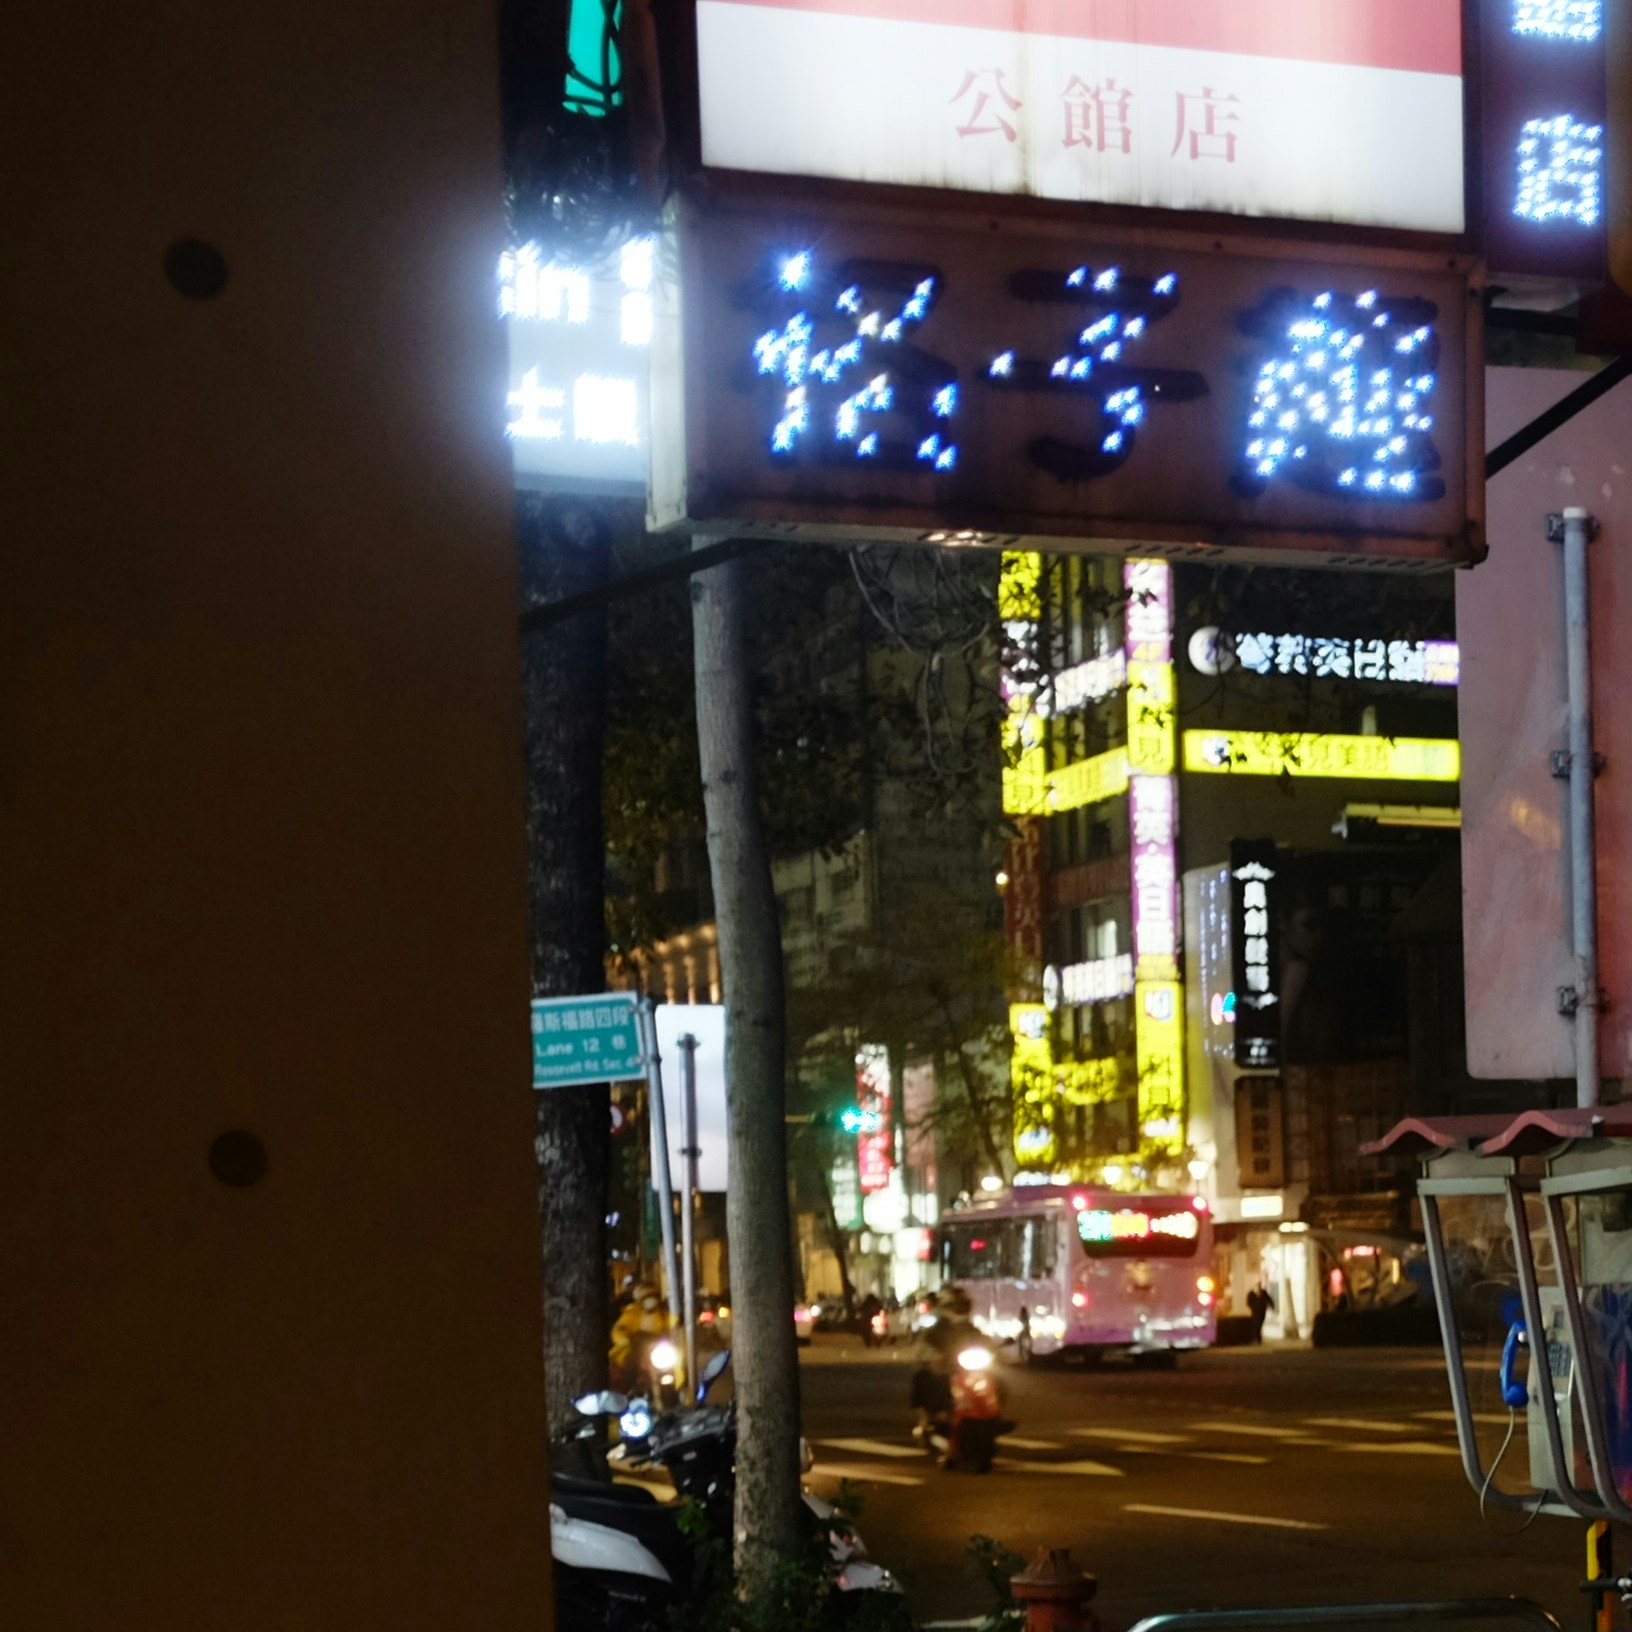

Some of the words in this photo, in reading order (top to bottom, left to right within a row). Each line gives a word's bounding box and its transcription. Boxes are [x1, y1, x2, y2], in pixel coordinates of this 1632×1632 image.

[950, 66, 1241, 164] 公館店
[536, 1043, 574, 1057] Lane
[582, 1037, 600, 1053] 12
